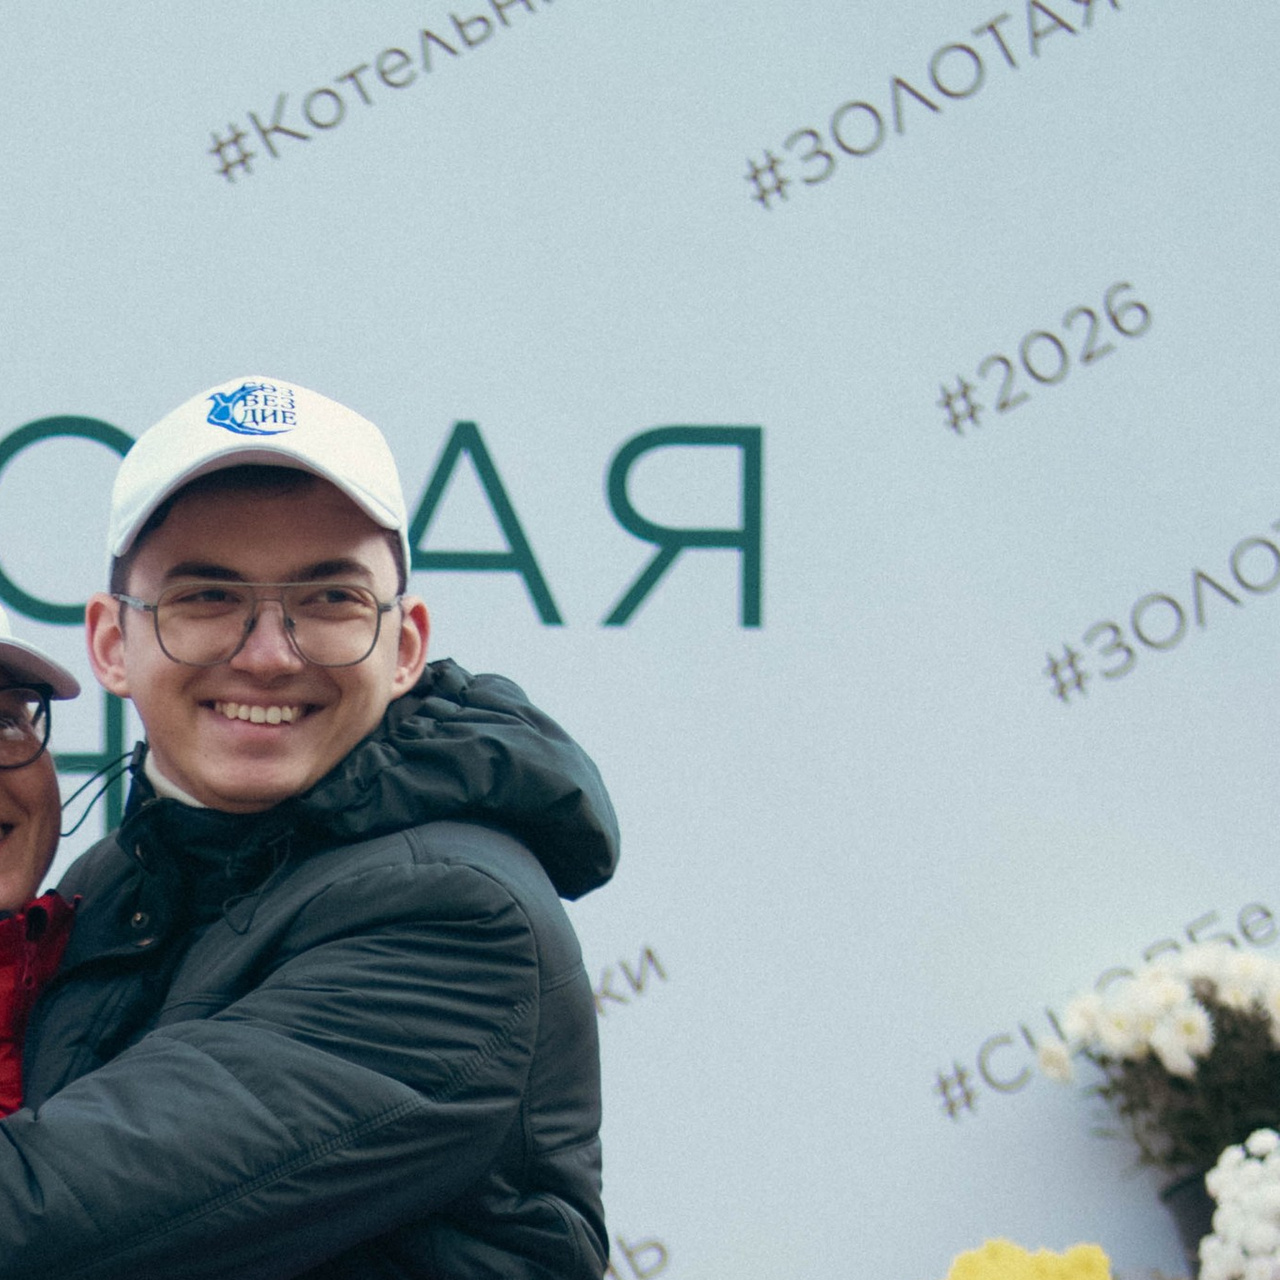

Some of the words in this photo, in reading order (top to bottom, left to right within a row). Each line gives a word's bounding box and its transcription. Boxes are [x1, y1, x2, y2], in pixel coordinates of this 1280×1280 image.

[209, 0, 550, 183] #Котельн
[241, 408, 297, 426] ДИЕ
[242, 393, 296, 409] ВЕЗ
[938, 282, 1152, 435] #2026
[1045, 520, 1280, 703] #ЗОЛО
